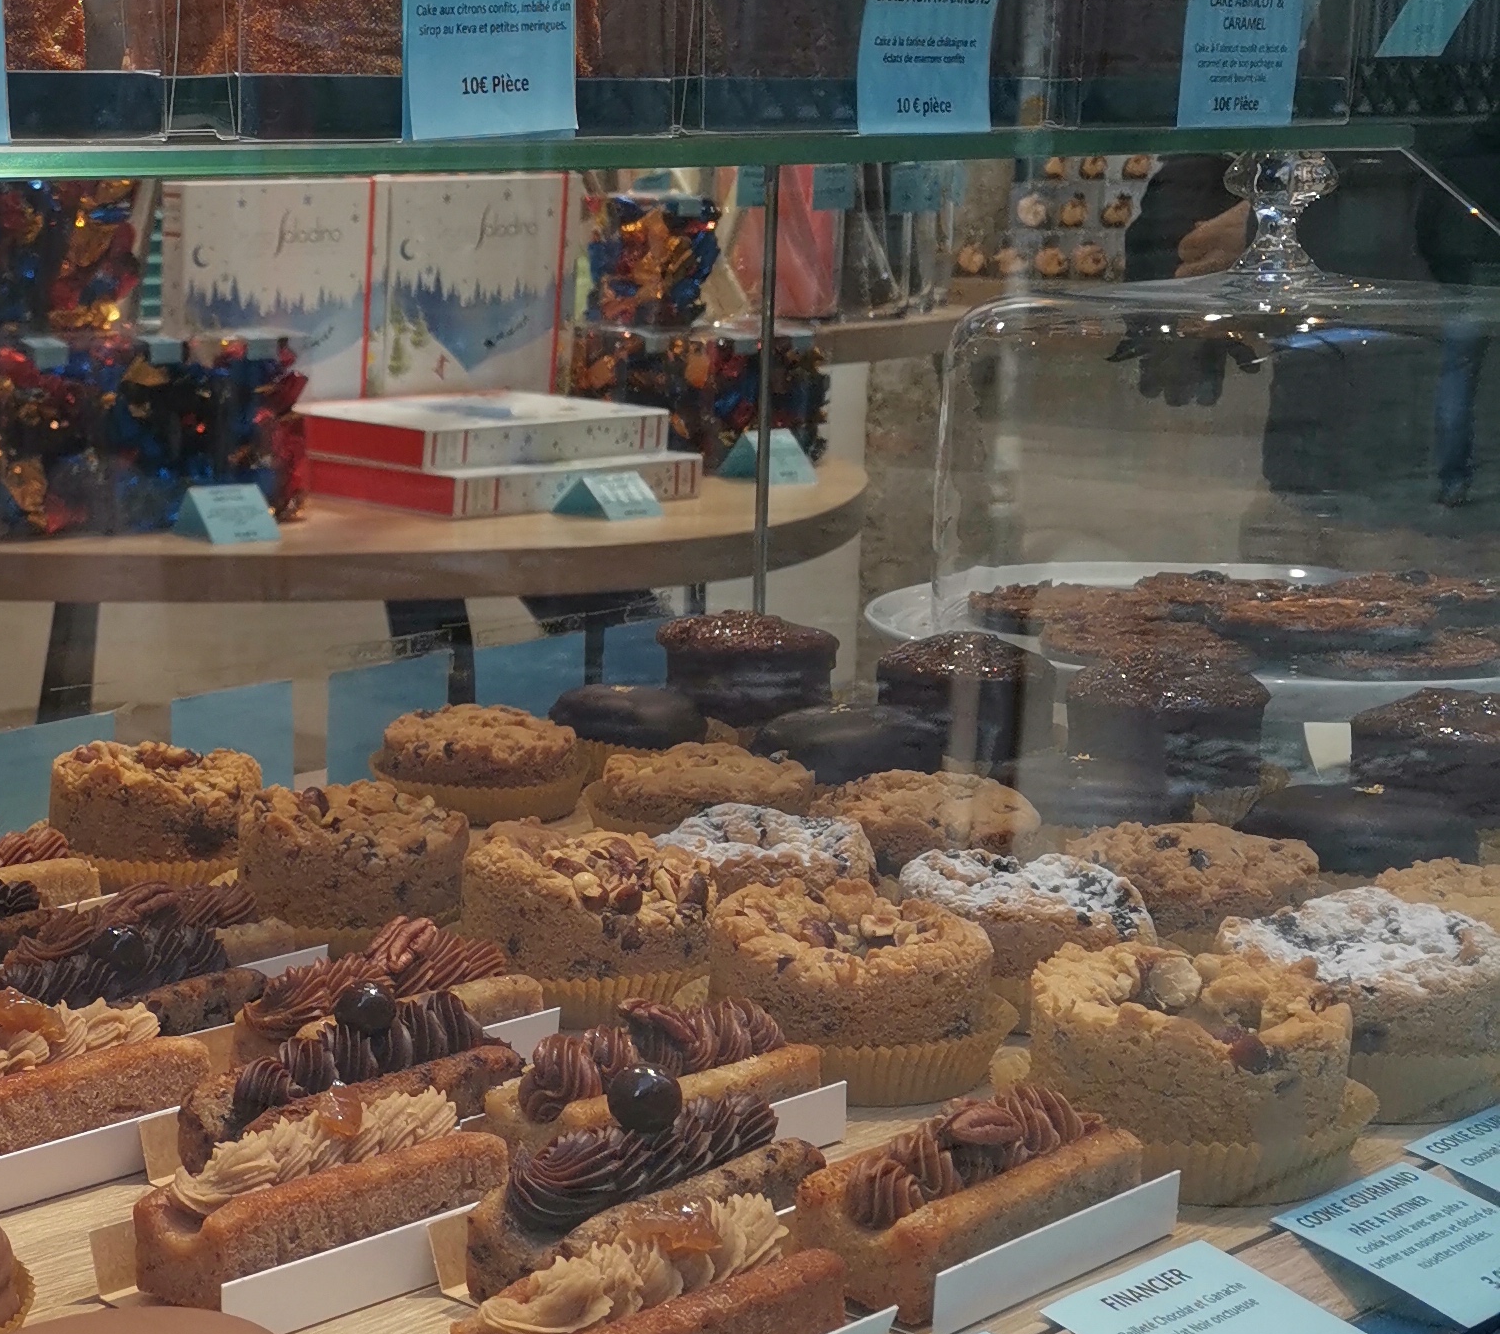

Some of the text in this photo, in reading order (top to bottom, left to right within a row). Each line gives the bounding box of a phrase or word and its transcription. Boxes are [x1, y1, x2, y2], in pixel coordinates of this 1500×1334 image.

[416, 1, 519, 16] Cake aux citrons confits,
[419, 21, 518, 37] sirop au et petites
[1223, 16, 1265, 30] CARAMEL
[462, 73, 528, 94] 10€ Pièce
[896, 96, 951, 116] 10 € pièce
[1213, 95, 1259, 111] 10€ Pièce
[1425, 1130, 1476, 1153] COOKIE
[1296, 1171, 1418, 1228] COOKIE GOURMAND
[1379, 1195, 1431, 1220] TARTINER
[1100, 1268, 1191, 1310] FINANCIER
[1152, 1304, 1197, 1325] Chocolat
[1193, 1299, 1208, 1309] et
[1202, 1282, 1246, 1303] Ganache
[1187, 1319, 1213, 1332] Noir
[1210, 1298, 1259, 1323] onctueuse
